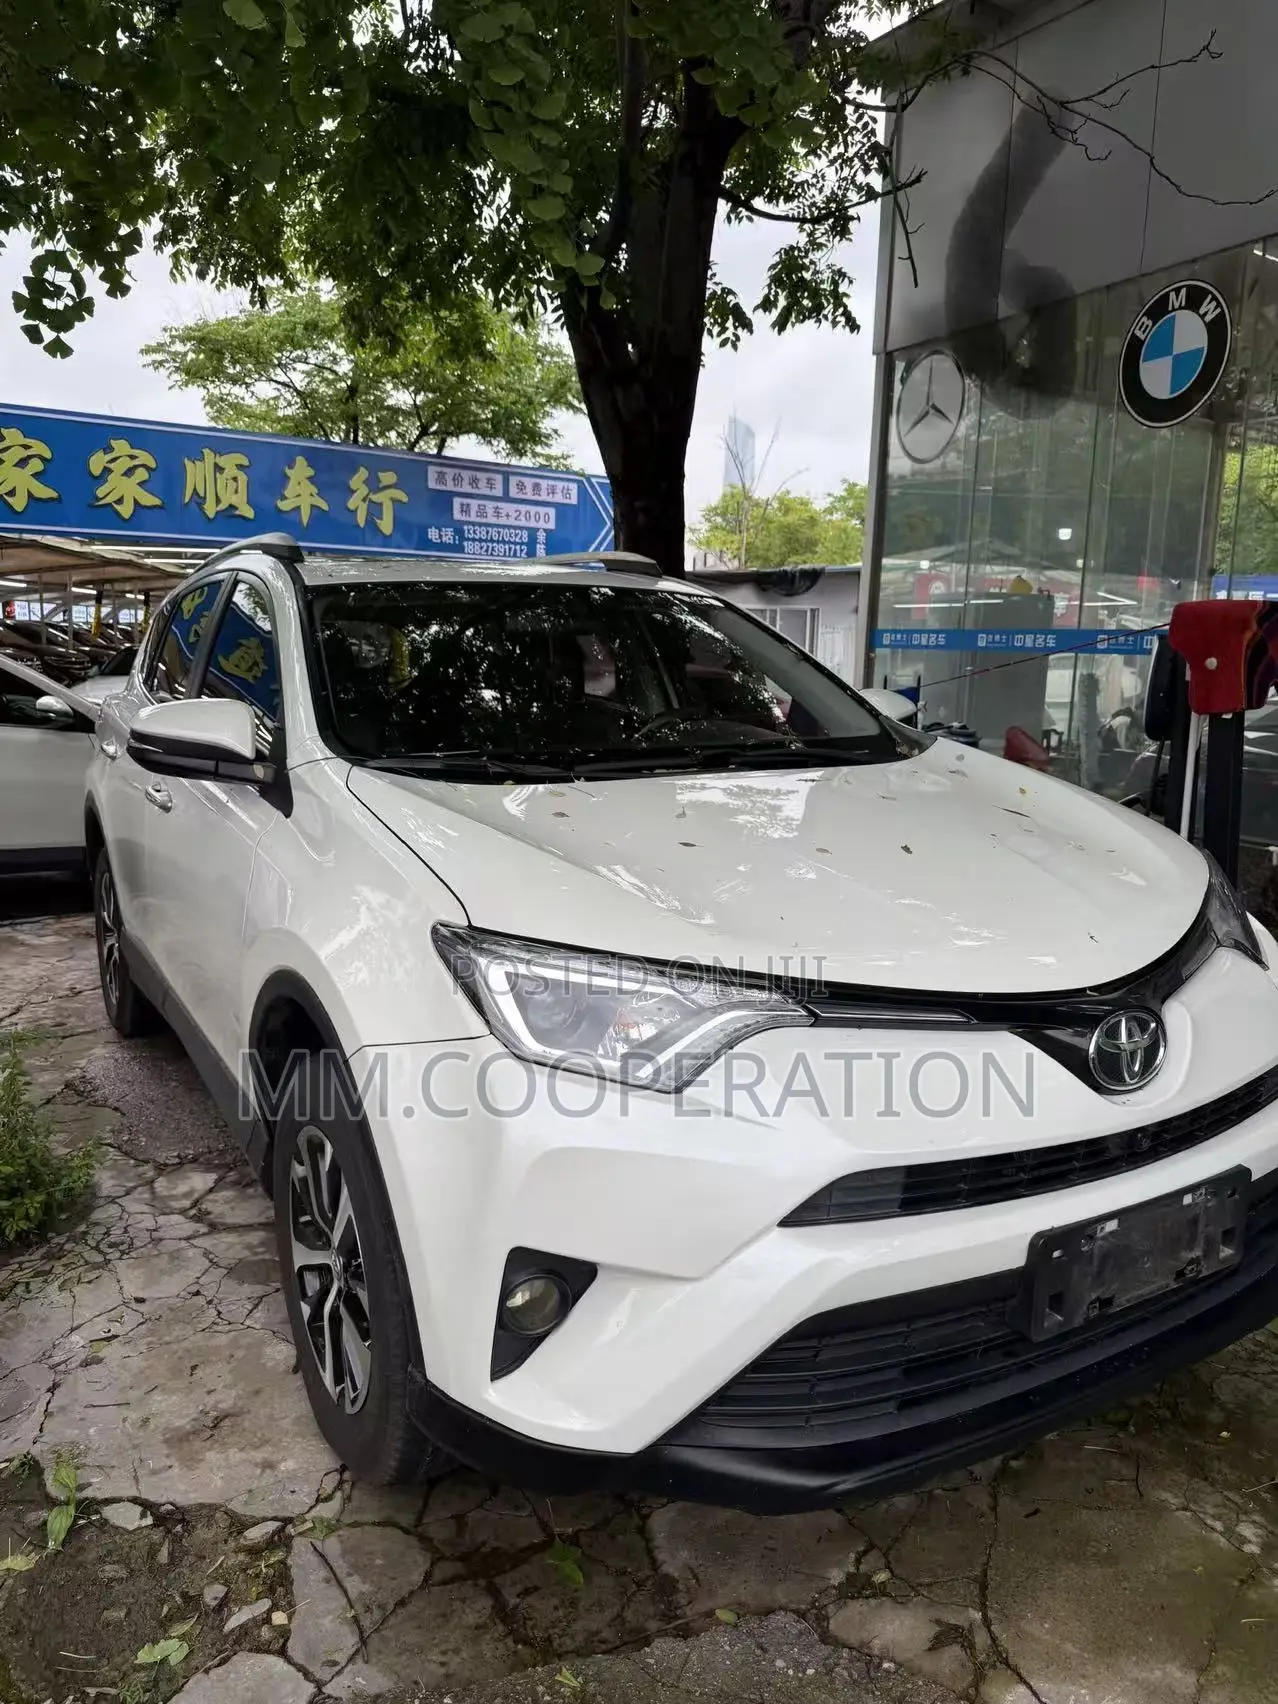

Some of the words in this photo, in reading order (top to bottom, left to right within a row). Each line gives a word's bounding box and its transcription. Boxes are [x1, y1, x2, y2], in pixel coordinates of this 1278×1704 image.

[1134, 287, 1222, 341] BMW
[0, 427, 409, 536] 家家顺车行
[434, 470, 498, 492] 高价收车
[515, 479, 573, 501] 免费评估
